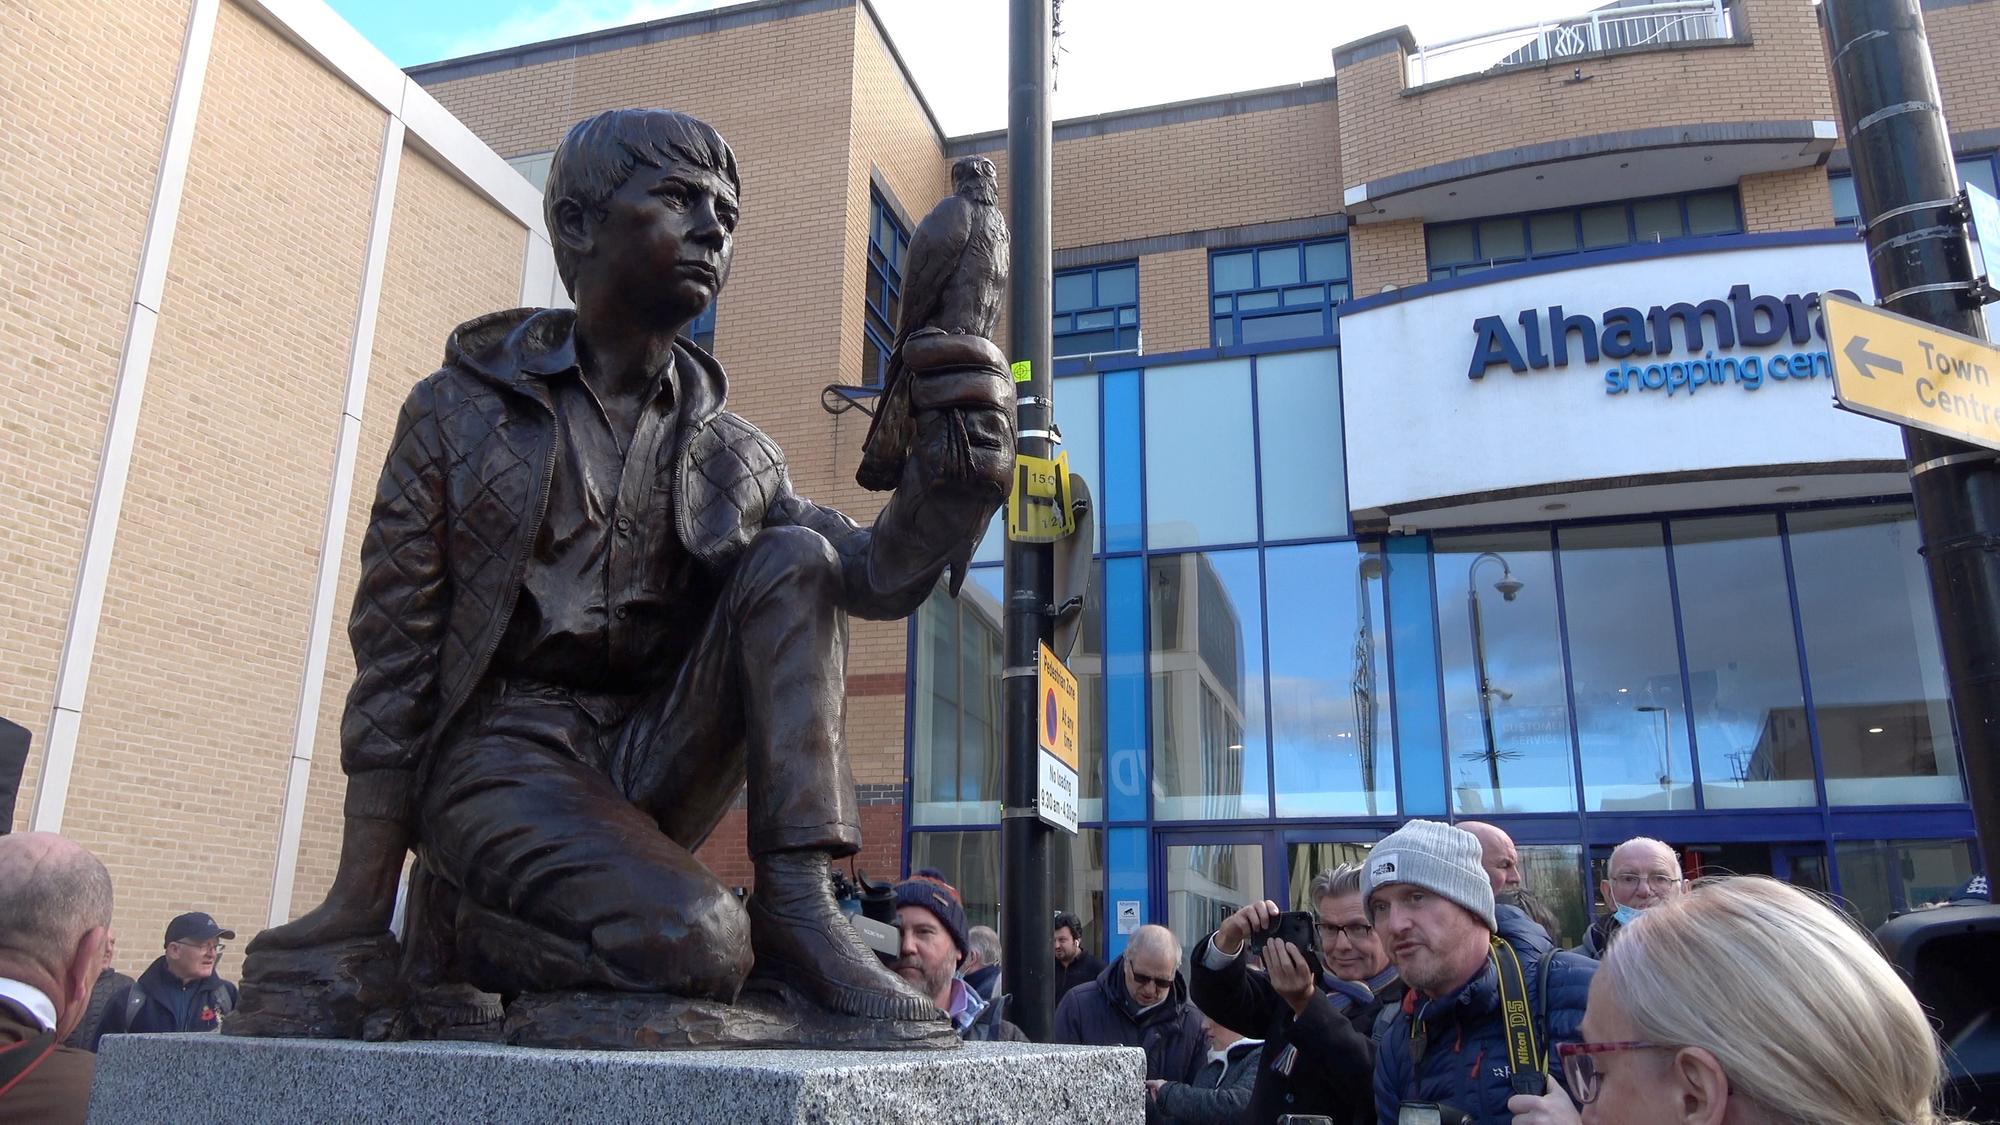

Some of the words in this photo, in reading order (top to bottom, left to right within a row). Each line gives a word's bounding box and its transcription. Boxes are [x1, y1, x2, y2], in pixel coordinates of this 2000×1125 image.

[1468, 284, 1862, 379] Alhambr
[1605, 351, 1763, 396] shopping
[1768, 350, 1831, 380] cen
[1918, 340, 1990, 387] Town
[1032, 473, 1055, 485] 150
[1043, 654, 1066, 691] Pedestrian
[1066, 677, 1076, 701] Zone
[1063, 731, 1073, 752] time
[1049, 763, 1057, 784] No
[1056, 769, 1072, 797] loading
[1053, 799, 1060, 815] am
[1507, 1000, 1527, 1028] D5
[1517, 1032, 1530, 1065] Nikon
